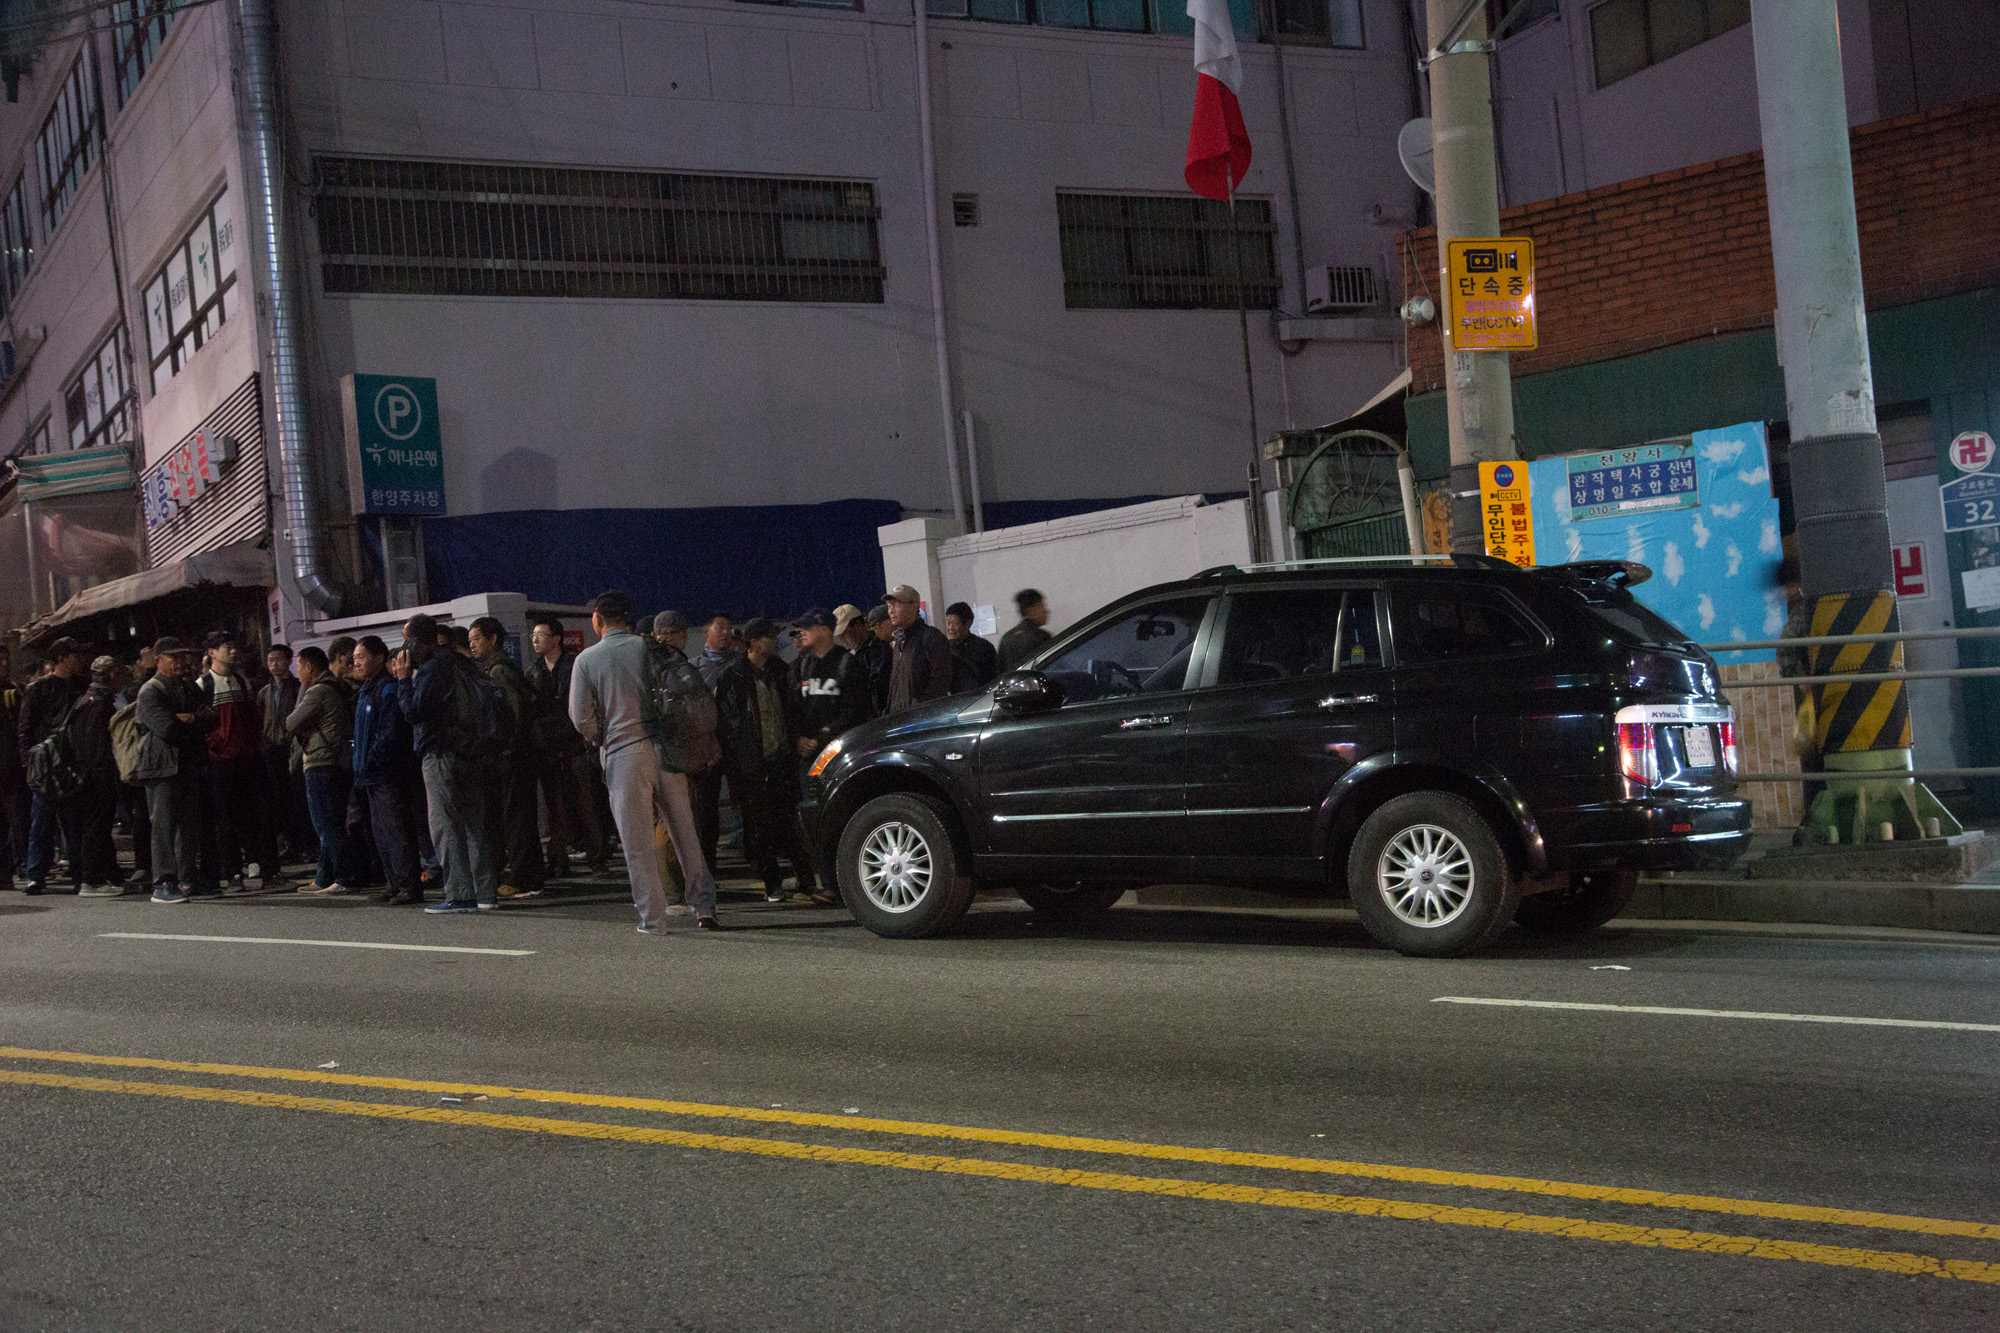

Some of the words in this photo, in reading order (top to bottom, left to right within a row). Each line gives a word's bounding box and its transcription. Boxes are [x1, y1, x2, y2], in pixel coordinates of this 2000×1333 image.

[1465, 299, 1520, 313] 불법주정차
[388, 395, 411, 429] P
[388, 450, 438, 467] 하나은행
[371, 489, 440, 507] 한양주차장
[1500, 491, 1518, 499] CCTV
[1964, 500, 1996, 523] 32
